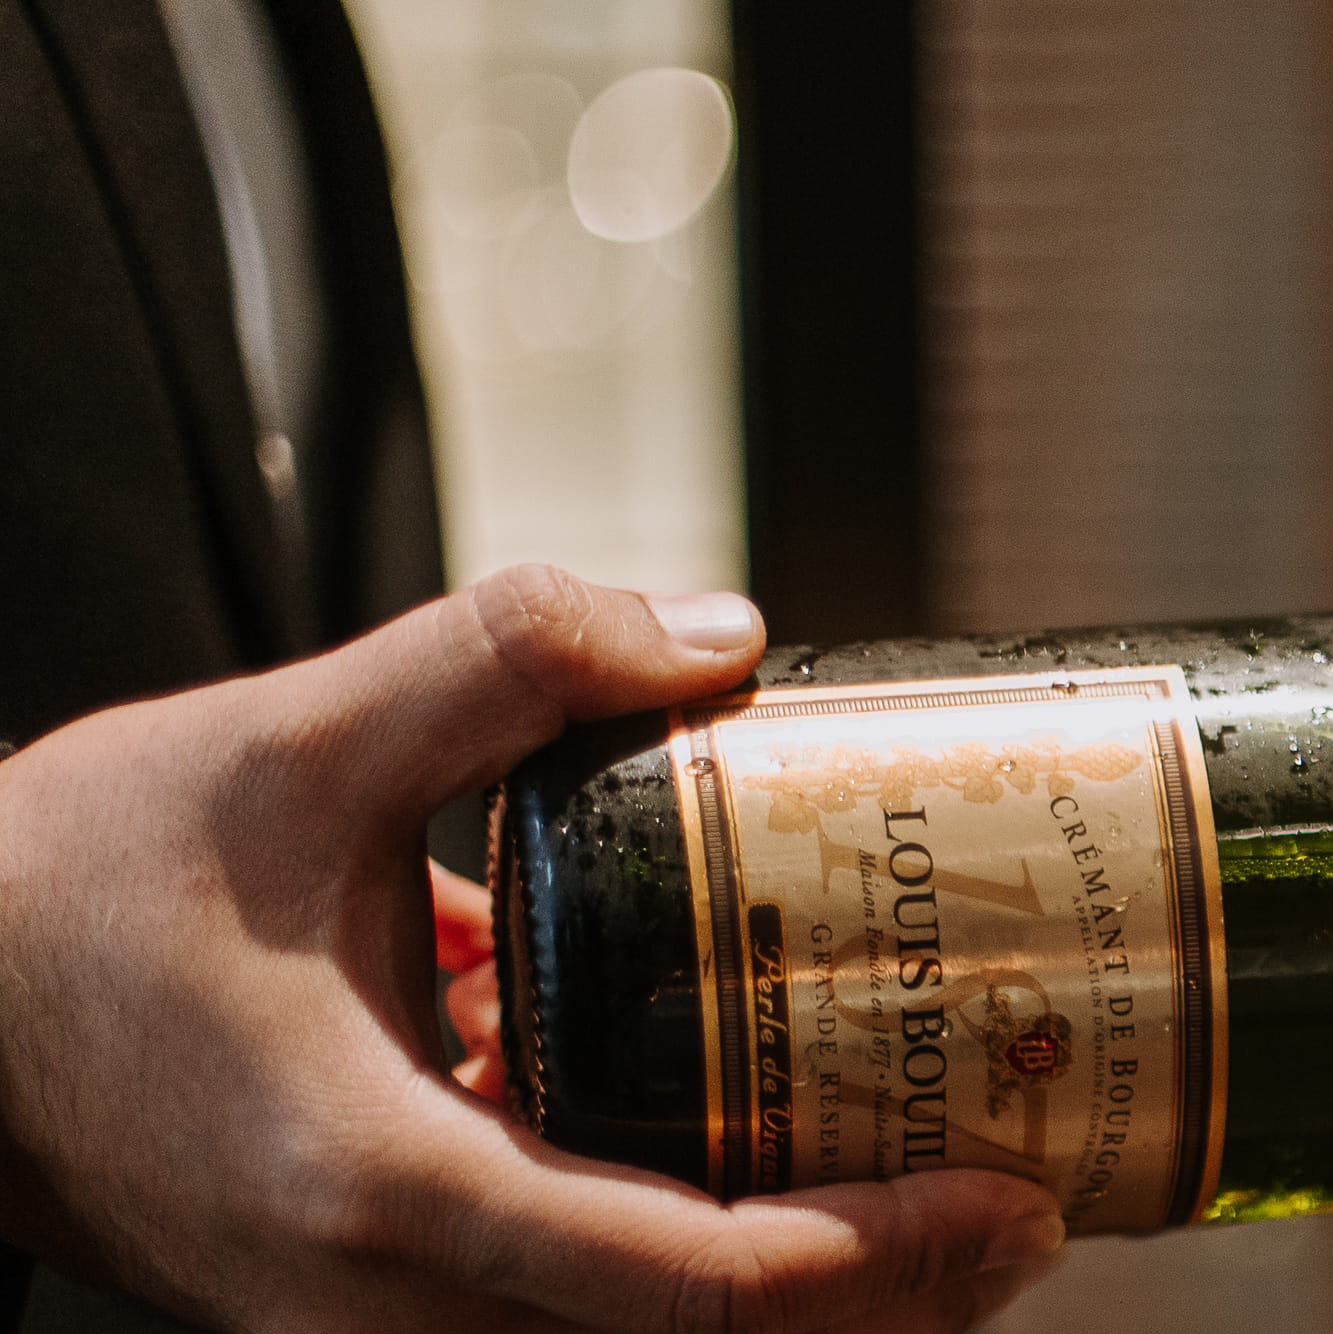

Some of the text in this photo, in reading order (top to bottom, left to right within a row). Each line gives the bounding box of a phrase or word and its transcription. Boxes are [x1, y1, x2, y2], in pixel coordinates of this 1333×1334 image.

[856, 848, 879, 918] Maison
[752, 939, 788, 1044] Perle
[810, 923, 838, 1056] GRANDE
[865, 926, 887, 991] Fondée
[882, 805, 948, 1175] LOUIS BOUIL
[869, 997, 883, 1018] en
[1049, 795, 1139, 1226] CRÉMANT DE BOURGO
[761, 1057, 790, 1093] de
[869, 1026, 892, 1070] 1877
